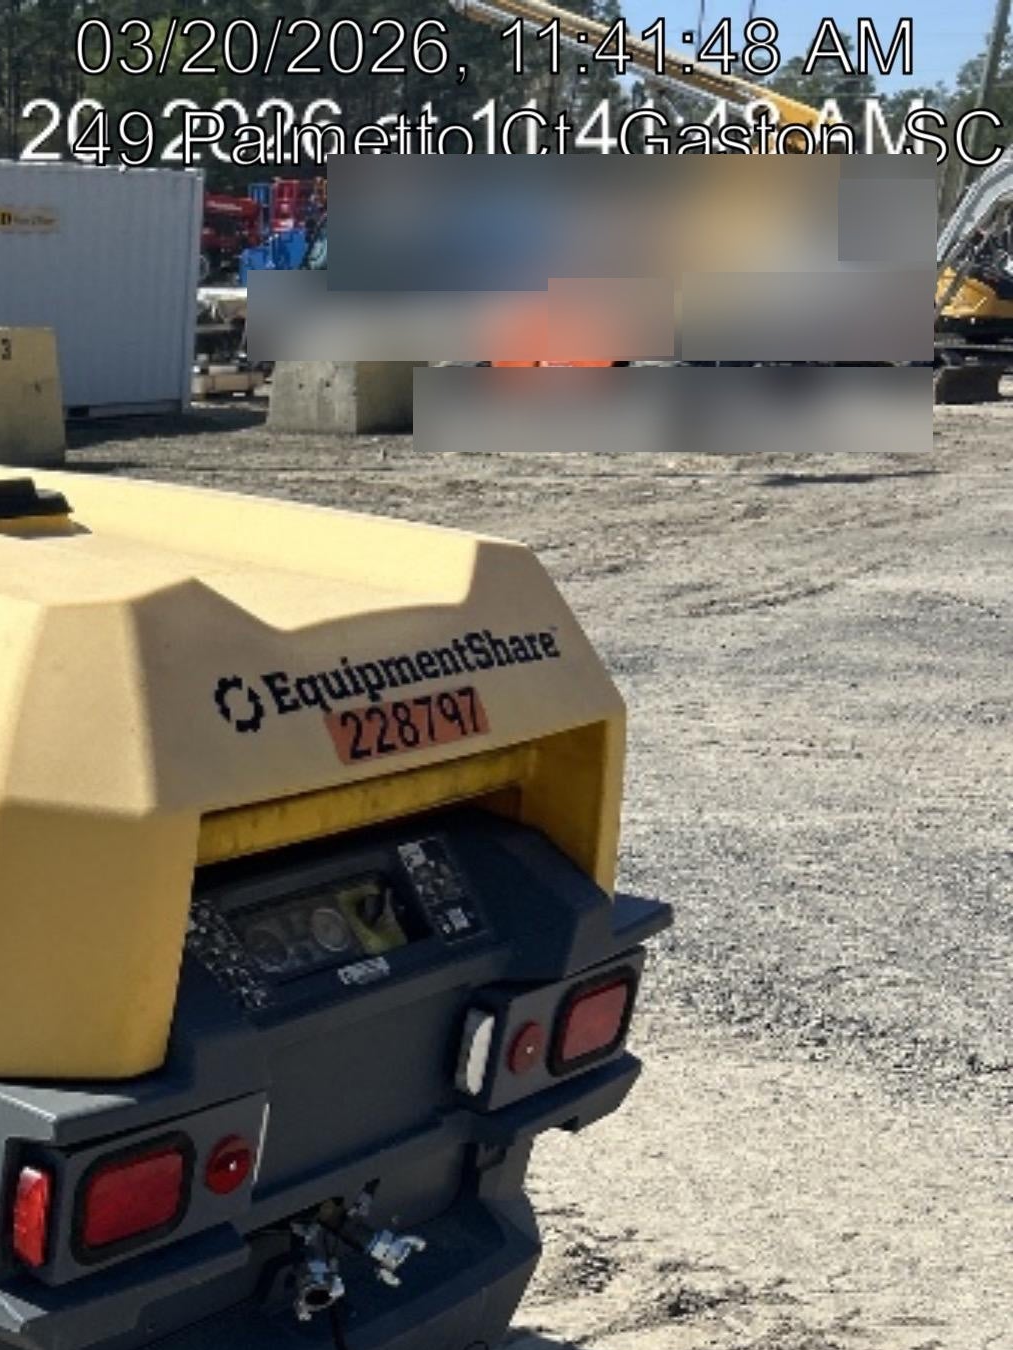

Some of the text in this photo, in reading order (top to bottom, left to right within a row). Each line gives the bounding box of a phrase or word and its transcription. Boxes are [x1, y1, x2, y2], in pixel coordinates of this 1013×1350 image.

[0, 338, 13, 360] 3
[261, 630, 561, 712] EquipmentShare
[341, 686, 480, 759] 228797
